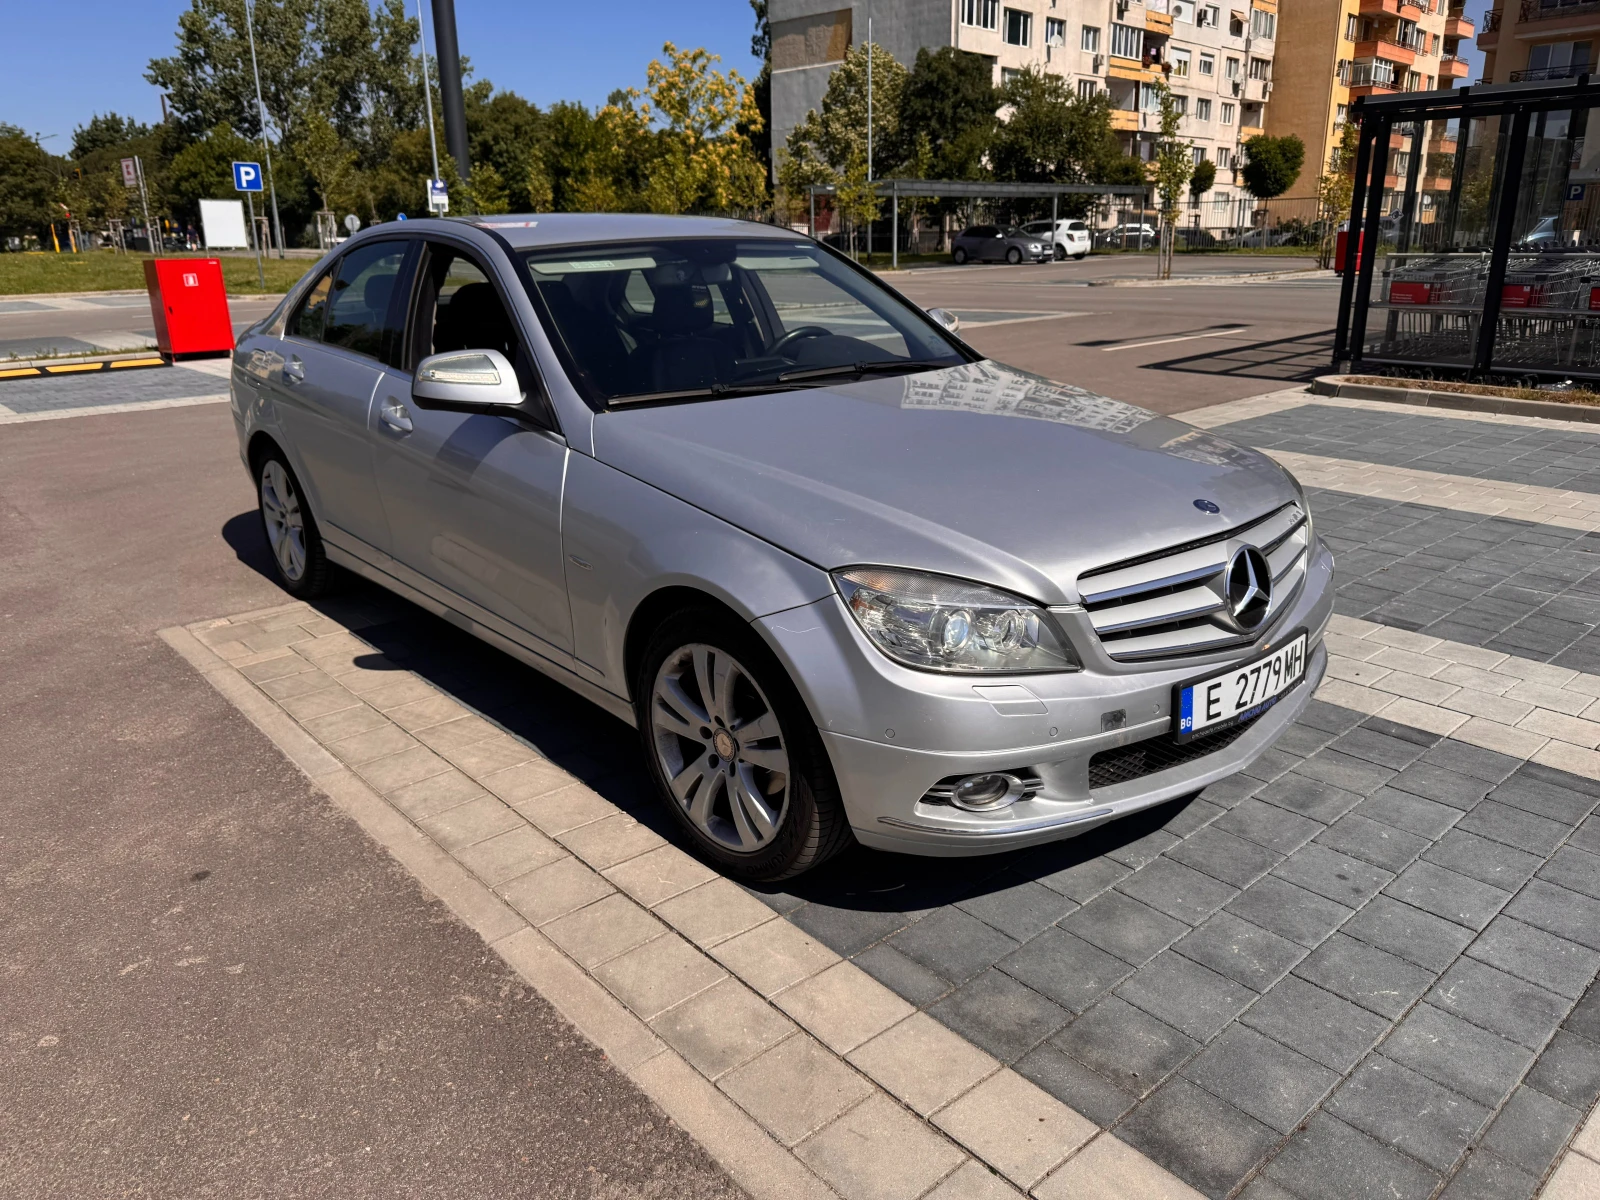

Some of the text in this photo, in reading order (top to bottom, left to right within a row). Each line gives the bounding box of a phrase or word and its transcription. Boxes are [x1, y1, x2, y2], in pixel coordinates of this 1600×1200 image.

[240, 166, 255, 188] P
[1570, 185, 1582, 199] P
[1206, 682, 1222, 722] E
[1235, 655, 1282, 710] 2779
[1284, 640, 1303, 684] MH
[1180, 716, 1192, 729] BG
[745, 849, 788, 875] KUMHO
